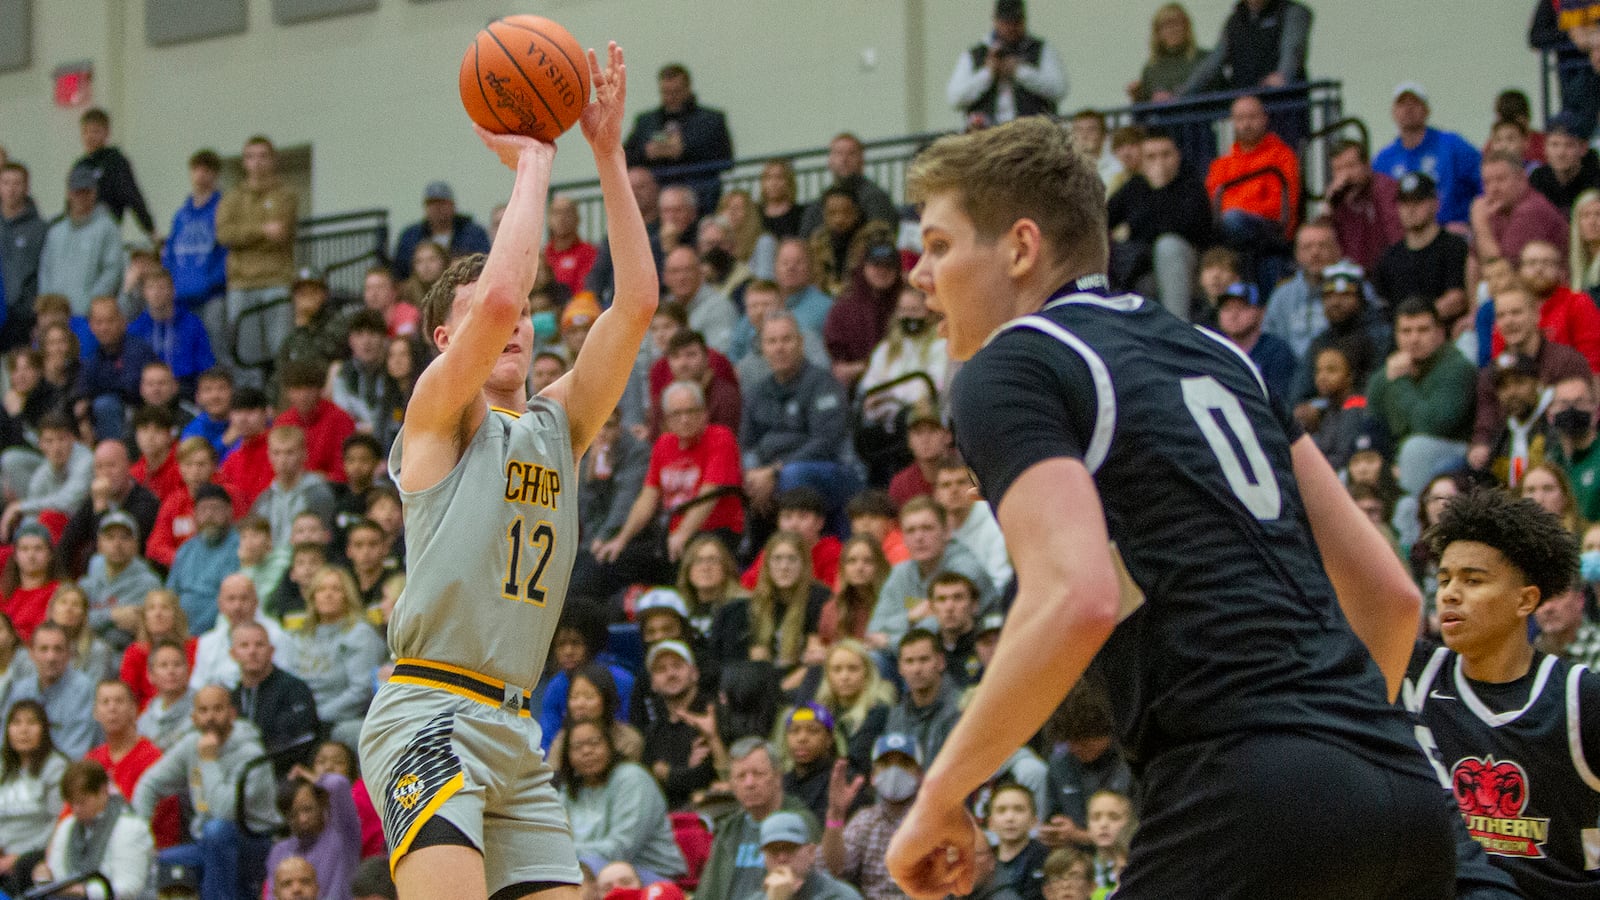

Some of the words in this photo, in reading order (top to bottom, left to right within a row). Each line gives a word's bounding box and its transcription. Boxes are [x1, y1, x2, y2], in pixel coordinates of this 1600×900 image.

[527, 41, 575, 107] OHSAA
[1181, 376, 1281, 520] 0
[501, 514, 557, 608] 12
[393, 779, 425, 799] ELKS
